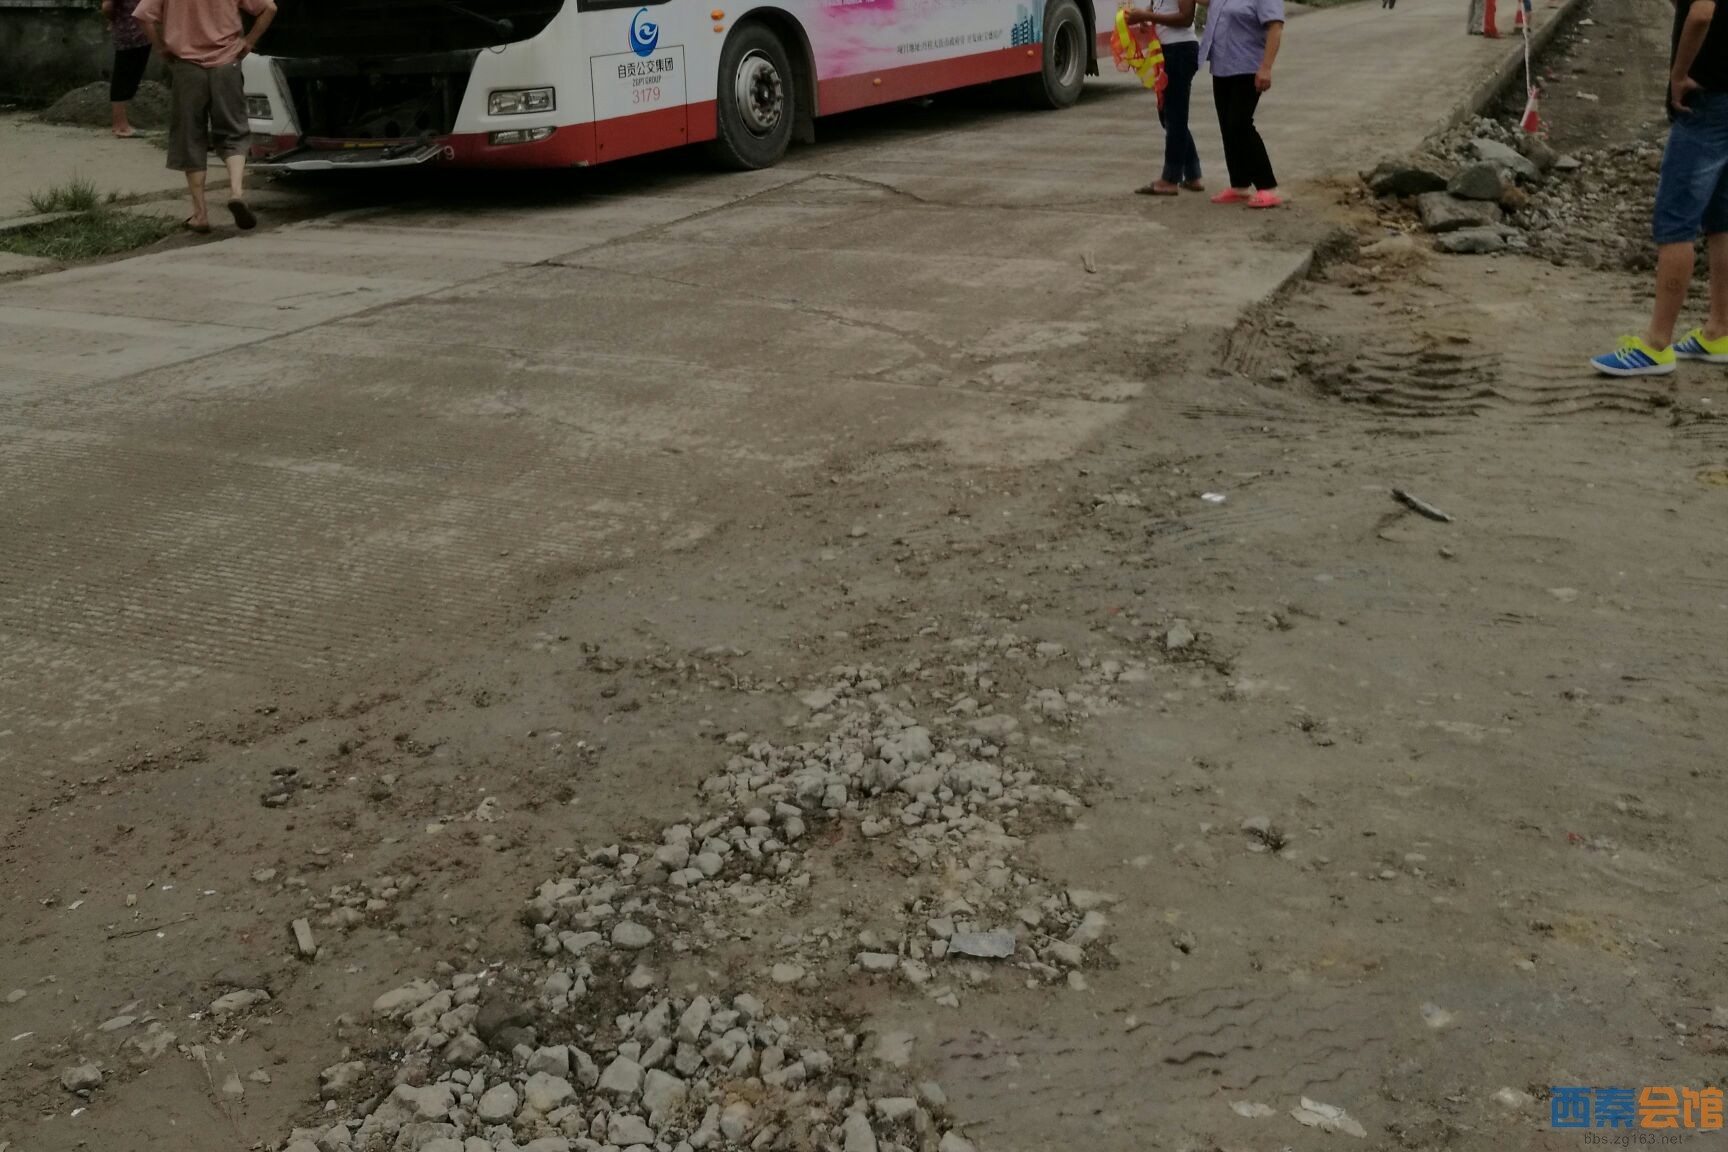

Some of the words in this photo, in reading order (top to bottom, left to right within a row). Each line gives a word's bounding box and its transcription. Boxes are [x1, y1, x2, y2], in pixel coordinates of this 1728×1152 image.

[617, 57, 674, 79] 自贡公交集团
[645, 75, 662, 85] GROUP
[632, 86, 661, 104] 3179
